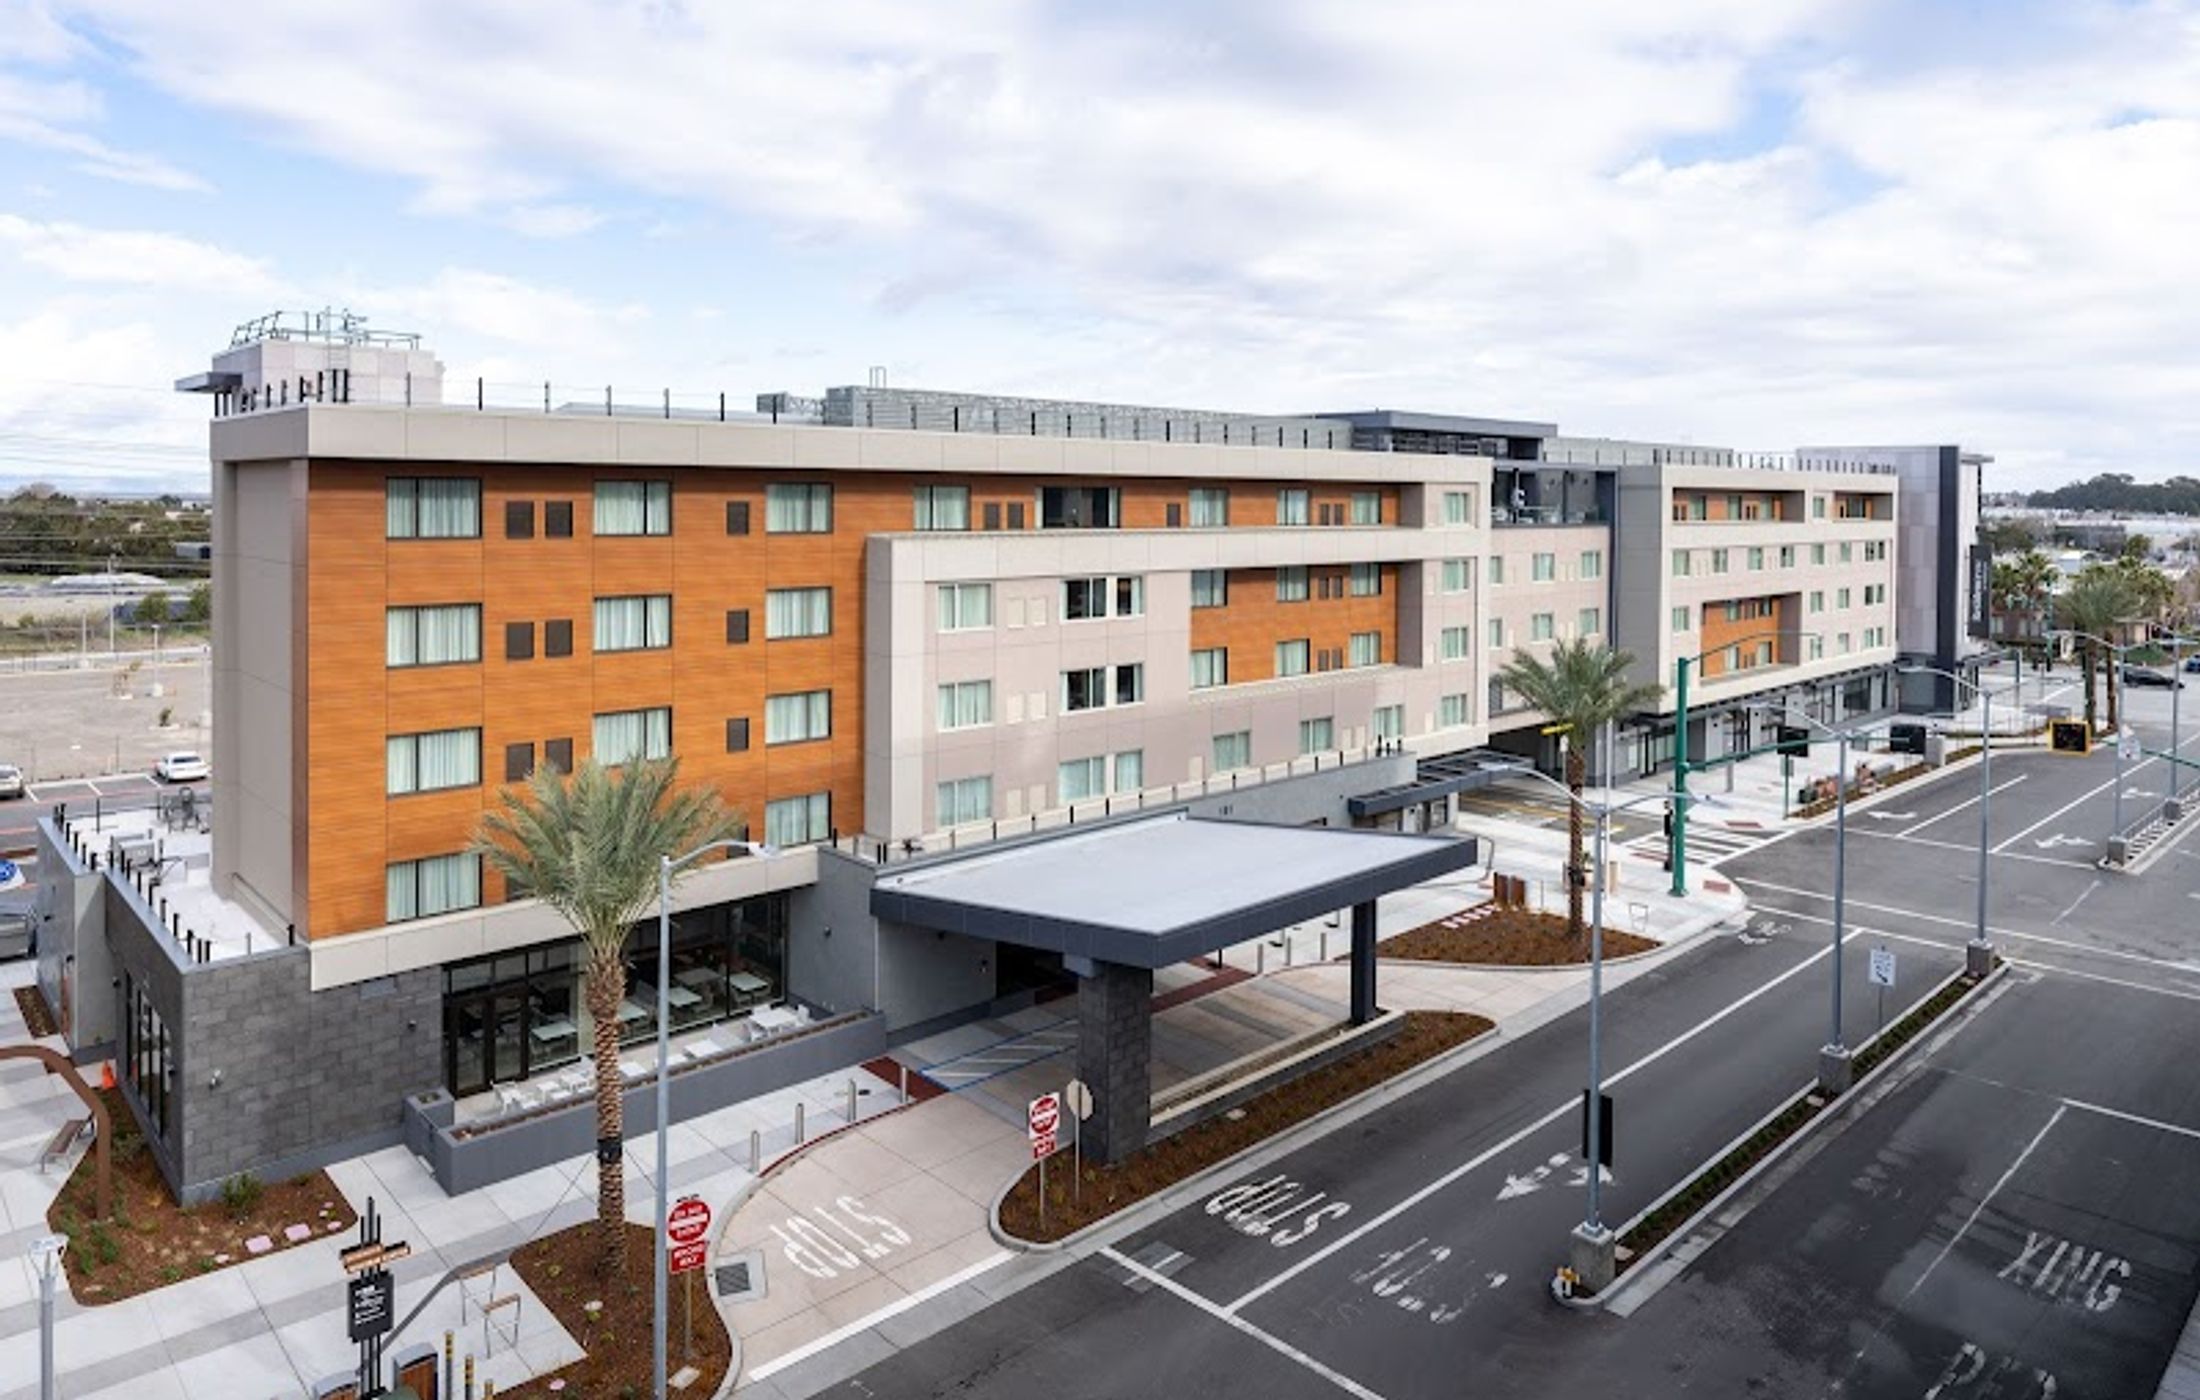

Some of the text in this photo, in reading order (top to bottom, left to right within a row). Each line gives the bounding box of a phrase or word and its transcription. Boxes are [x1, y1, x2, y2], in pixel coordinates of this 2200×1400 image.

[769, 1196, 912, 1278] STOP
[1204, 1174, 1351, 1247] STOP
[1997, 1231, 2132, 1311] XING
